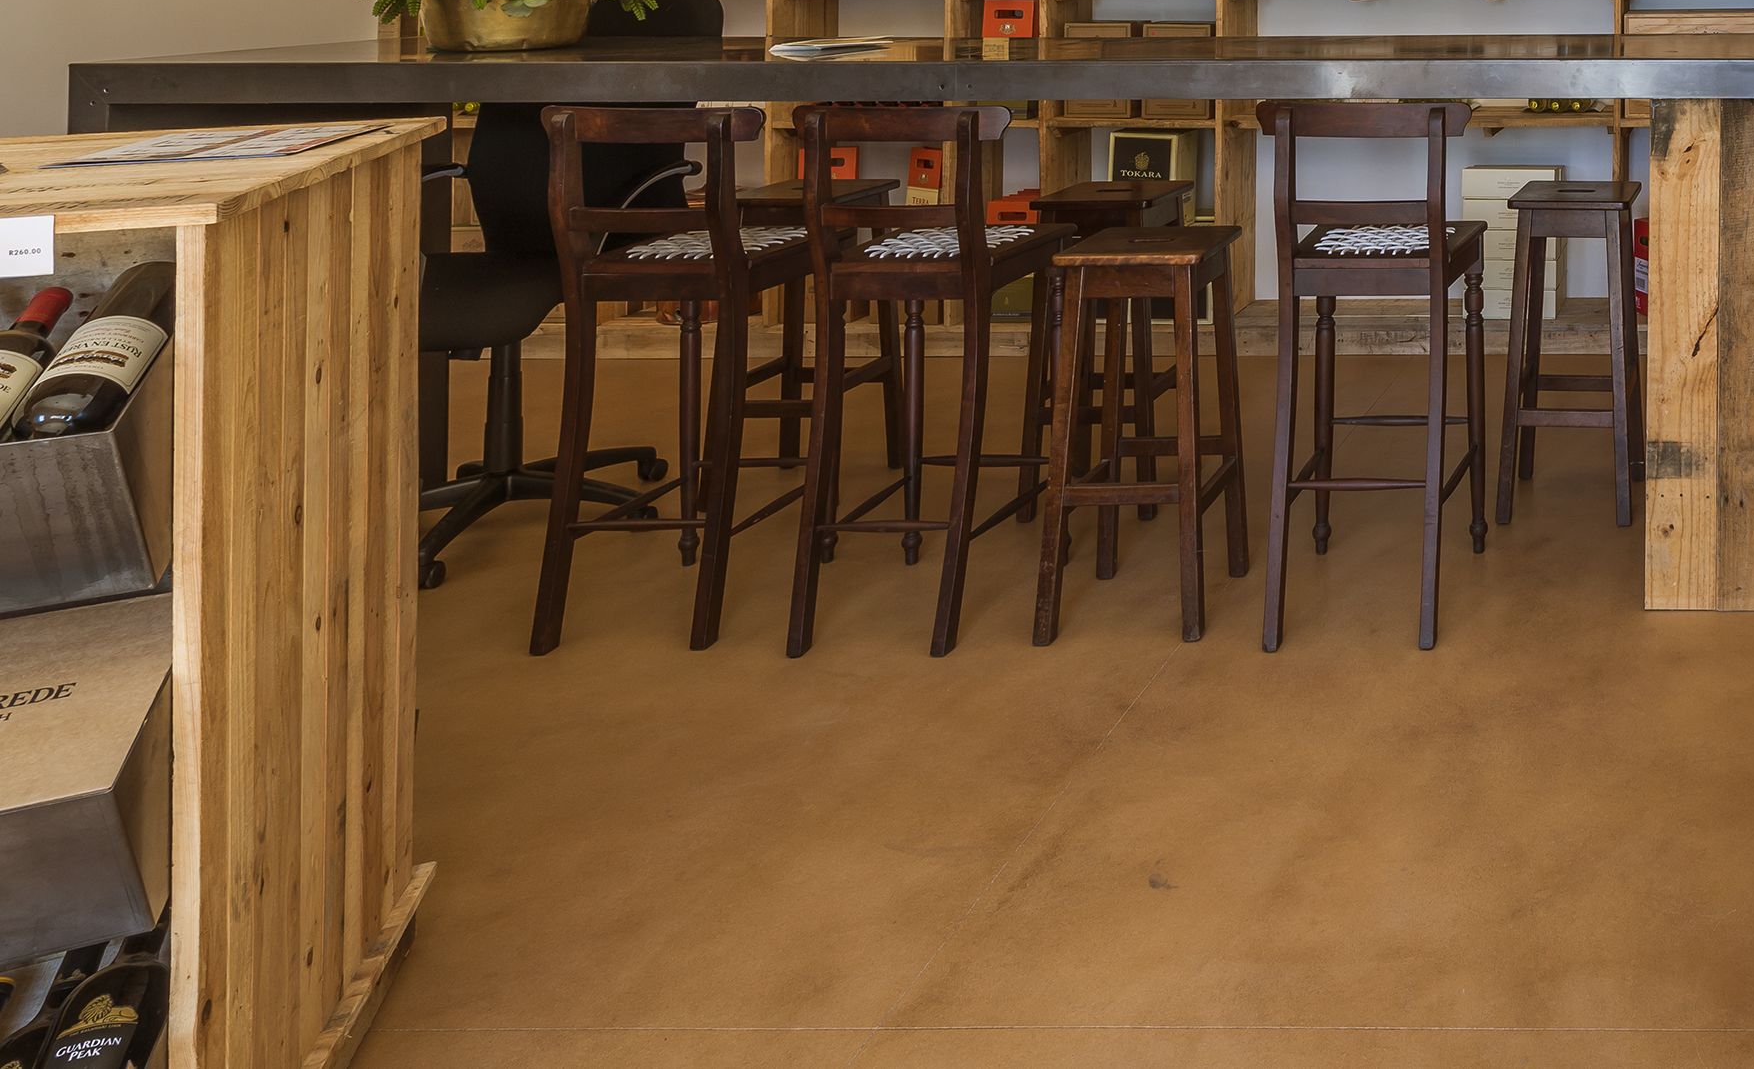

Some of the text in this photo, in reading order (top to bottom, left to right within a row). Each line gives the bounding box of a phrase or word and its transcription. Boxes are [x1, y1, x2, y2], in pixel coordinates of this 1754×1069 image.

[1120, 170, 1162, 179] TOKARA
[9, 248, 42, 256] R260.00
[110, 341, 143, 358] RUST
[55, 1037, 122, 1057] GUARDIAN
[68, 1047, 102, 1062] PEAK
